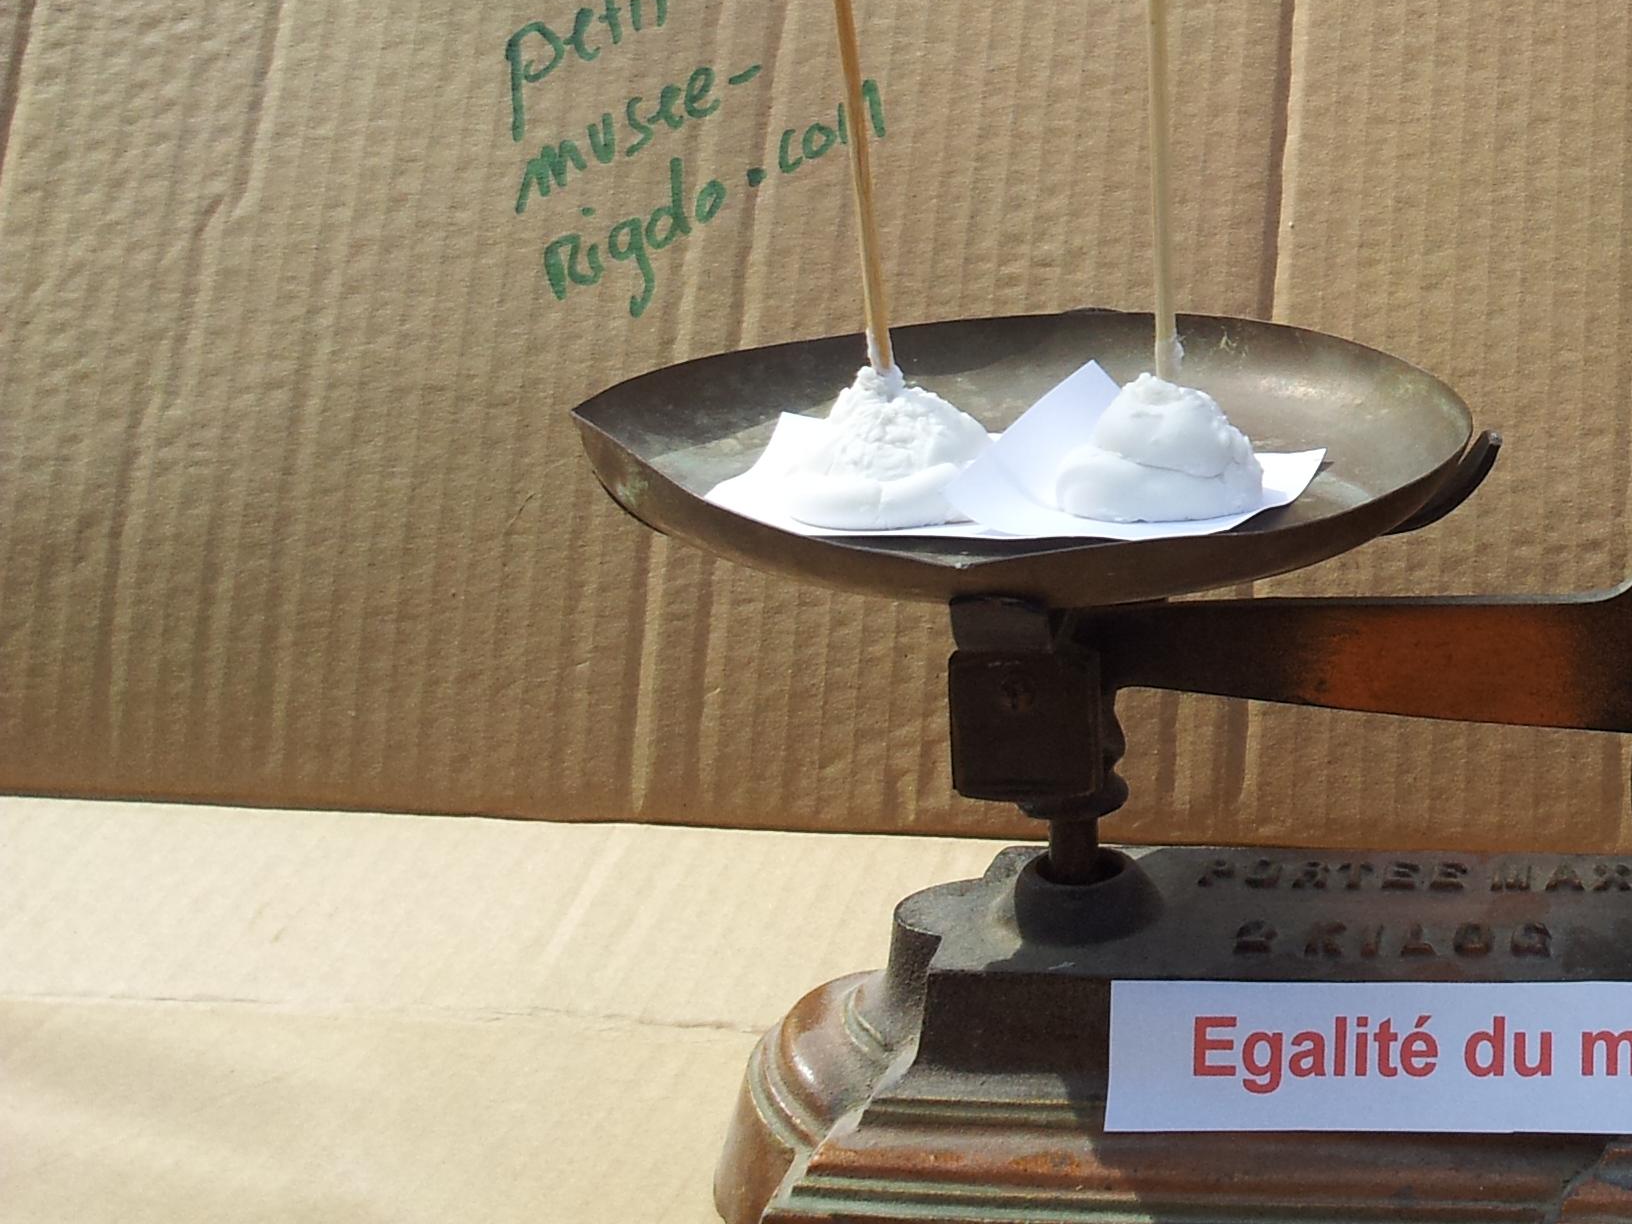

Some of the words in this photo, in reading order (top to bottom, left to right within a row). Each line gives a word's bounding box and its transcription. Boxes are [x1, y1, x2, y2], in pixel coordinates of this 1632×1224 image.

[514, 64, 763, 214] musee-
[1193, 1014, 1438, 1094] Egalité
[1464, 1016, 1552, 1077] du
